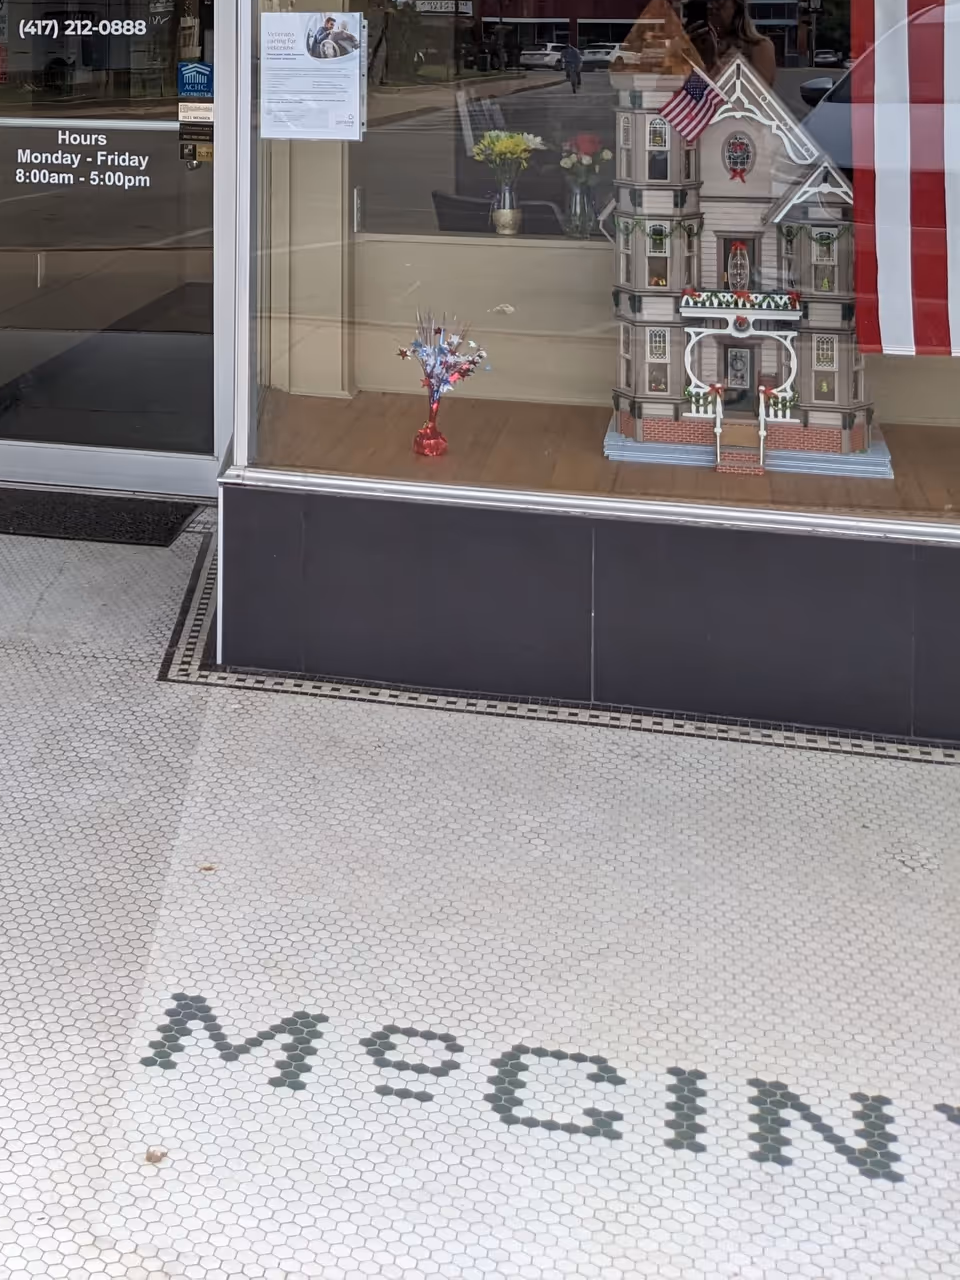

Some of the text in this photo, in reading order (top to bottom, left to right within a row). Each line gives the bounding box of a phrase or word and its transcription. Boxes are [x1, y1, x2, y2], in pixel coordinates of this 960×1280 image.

[19, 19, 147, 39] (417) 212-0888
[57, 130, 108, 146] Hours
[17, 148, 82, 168] Monday
[97, 151, 149, 170] Friday
[15, 168, 74, 184] 8:00am
[89, 171, 150, 190] 5:00pm
[140, 992, 960, 1184] McGIN
